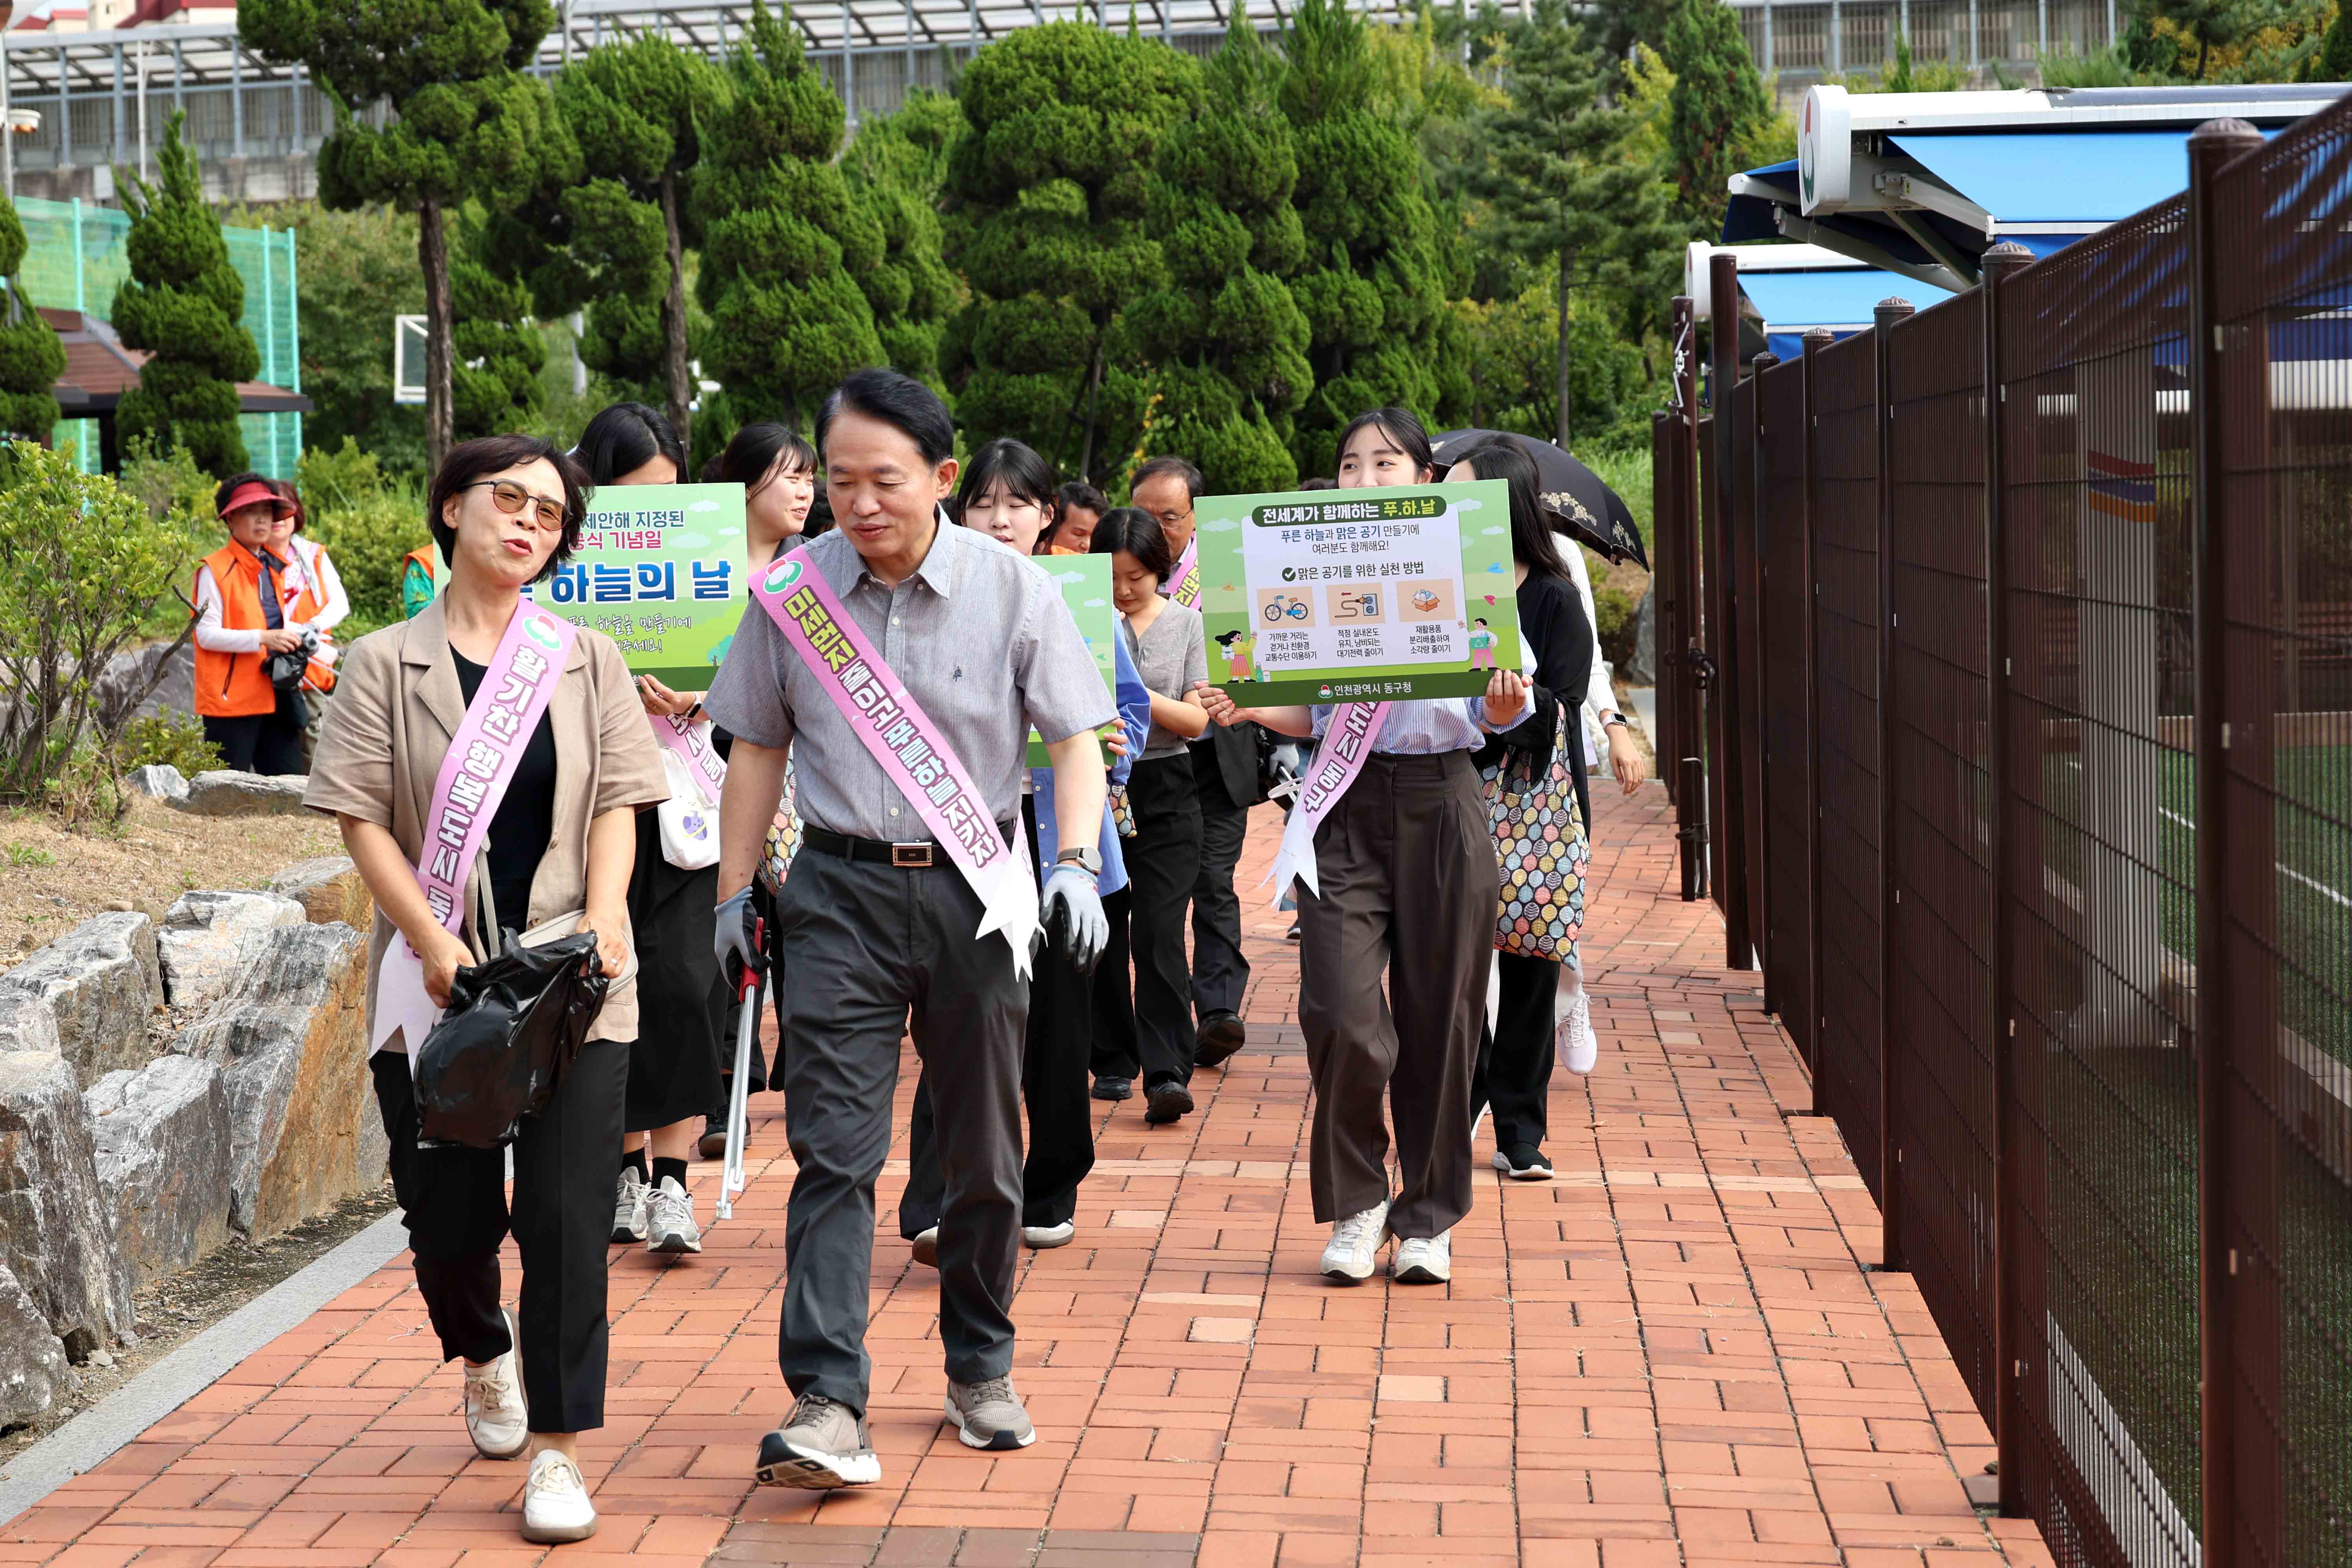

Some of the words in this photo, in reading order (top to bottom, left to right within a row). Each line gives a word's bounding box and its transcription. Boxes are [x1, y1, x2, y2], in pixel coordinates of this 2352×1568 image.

[636, 510, 684, 528] 지정된
[1263, 507, 1318, 524] 전세계가
[1323, 504, 1379, 521] 함께하는
[1383, 499, 1436, 517] 푸.하.날
[609, 531, 662, 549] 기념일
[1281, 529, 1301, 543] 푸른
[1305, 528, 1333, 541] 하늘과
[1336, 526, 1356, 539] 맑은
[1361, 526, 1381, 538] 공기
[1383, 524, 1420, 537] 만들기에
[1312, 542, 1347, 554] 여러분도
[1350, 540, 1390, 553] 함께해요!
[1298, 568, 1318, 581] 맑은
[1323, 566, 1352, 579] 공기를
[1356, 564, 1377, 578] 위한
[1380, 563, 1400, 576] 실천
[1404, 561, 1424, 575] 방법
[551, 562, 675, 603] 하늘의
[692, 561, 731, 599] 날
[596, 614, 634, 635] 하늘을
[639, 613, 691, 634] 만들기에
[1338, 629, 1350, 637] 적정
[1353, 628, 1379, 637] 실내온도
[1416, 625, 1442, 634] 재활용품
[1269, 633, 1287, 642] 가까운
[1289, 631, 1308, 641] 거리는
[1339, 638, 1353, 647] 유지,
[1355, 636, 1380, 647] 낭비되는
[1410, 633, 1449, 644] 분리배출하여
[1270, 642, 1288, 652] 걷거나
[1290, 641, 1309, 650] 친환경
[1337, 648, 1362, 658] 대기전력
[1364, 646, 1383, 657] 줄이기
[1410, 644, 1429, 654] 소각량
[1431, 642, 1451, 653] 줄이기
[1265, 651, 1290, 662] 교통수단
[1291, 650, 1317, 661] 이용하기
[482, 643, 548, 744] 활기찬
[1334, 683, 1381, 696] 인천광역시
[1384, 682, 1412, 694] 동구청
[783, 585, 859, 674] 미세먼지
[838, 659, 902, 732] 줄이고
[942, 794, 998, 868] 지키자
[1305, 760, 1346, 813] 동구
[431, 739, 504, 886] 행복도시
[427, 886, 453, 927] 동
